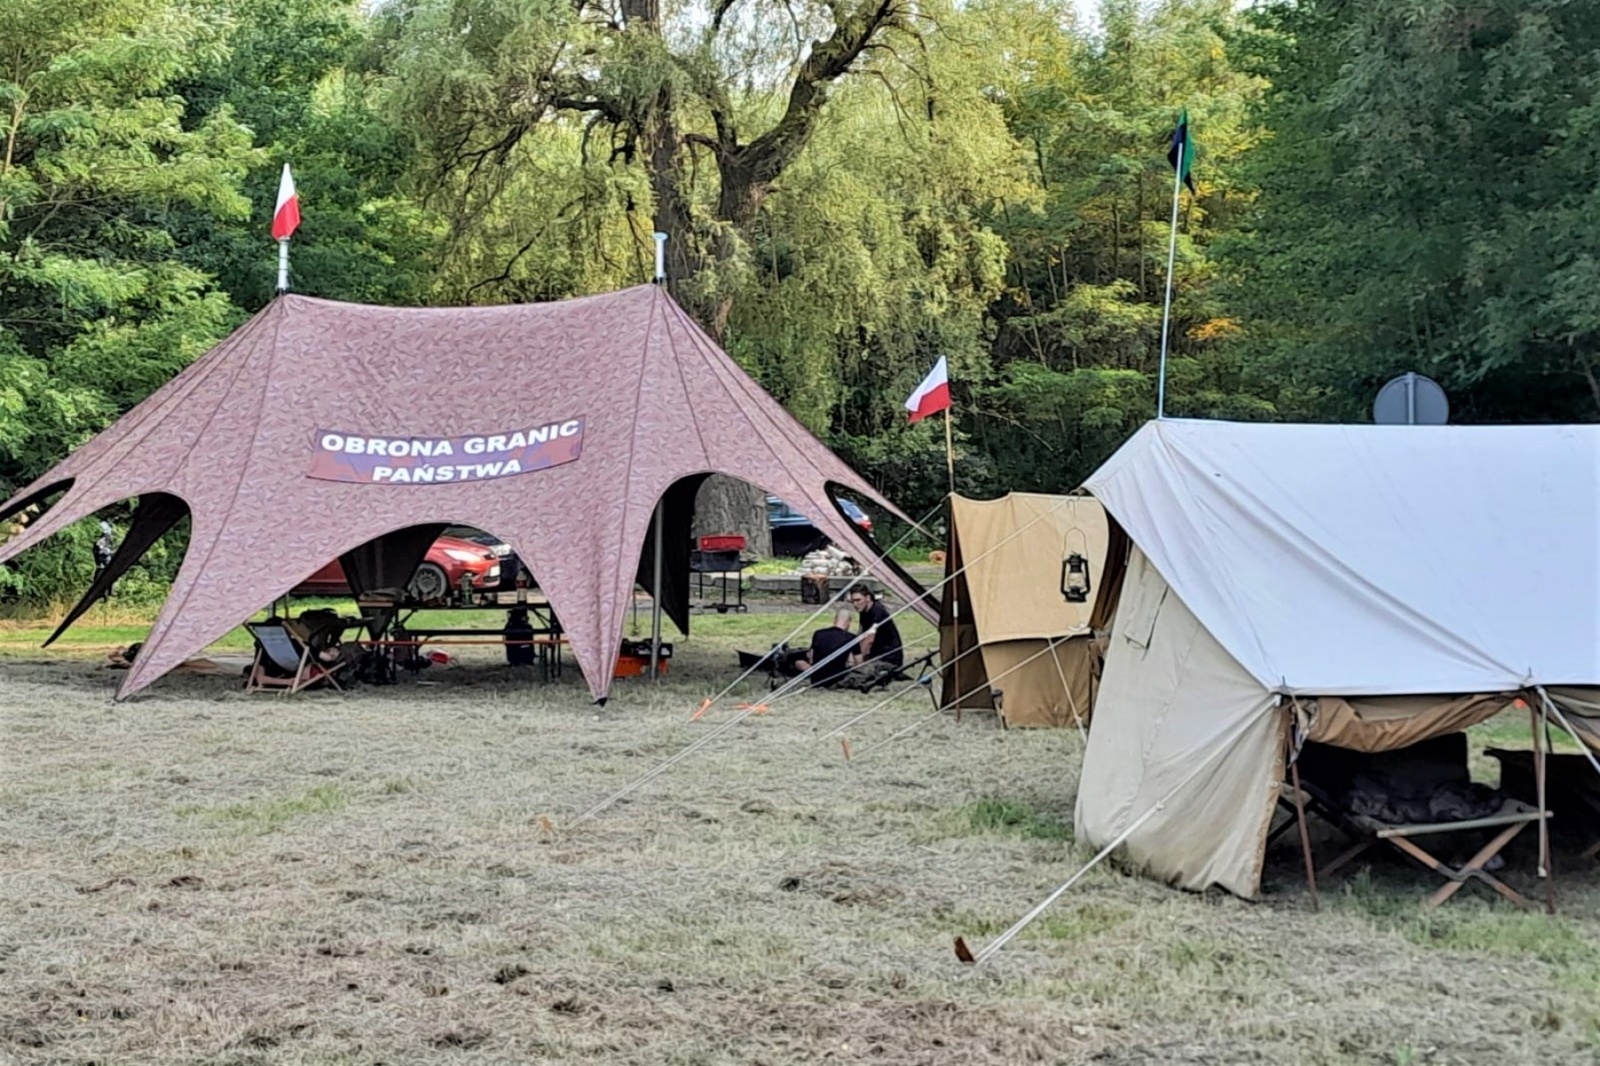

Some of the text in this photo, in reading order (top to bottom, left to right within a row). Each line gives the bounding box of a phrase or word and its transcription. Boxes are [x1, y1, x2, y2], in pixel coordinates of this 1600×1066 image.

[321, 420, 579, 456] OBRONA GRANIC
[372, 459, 521, 482] PAŃSTWA
